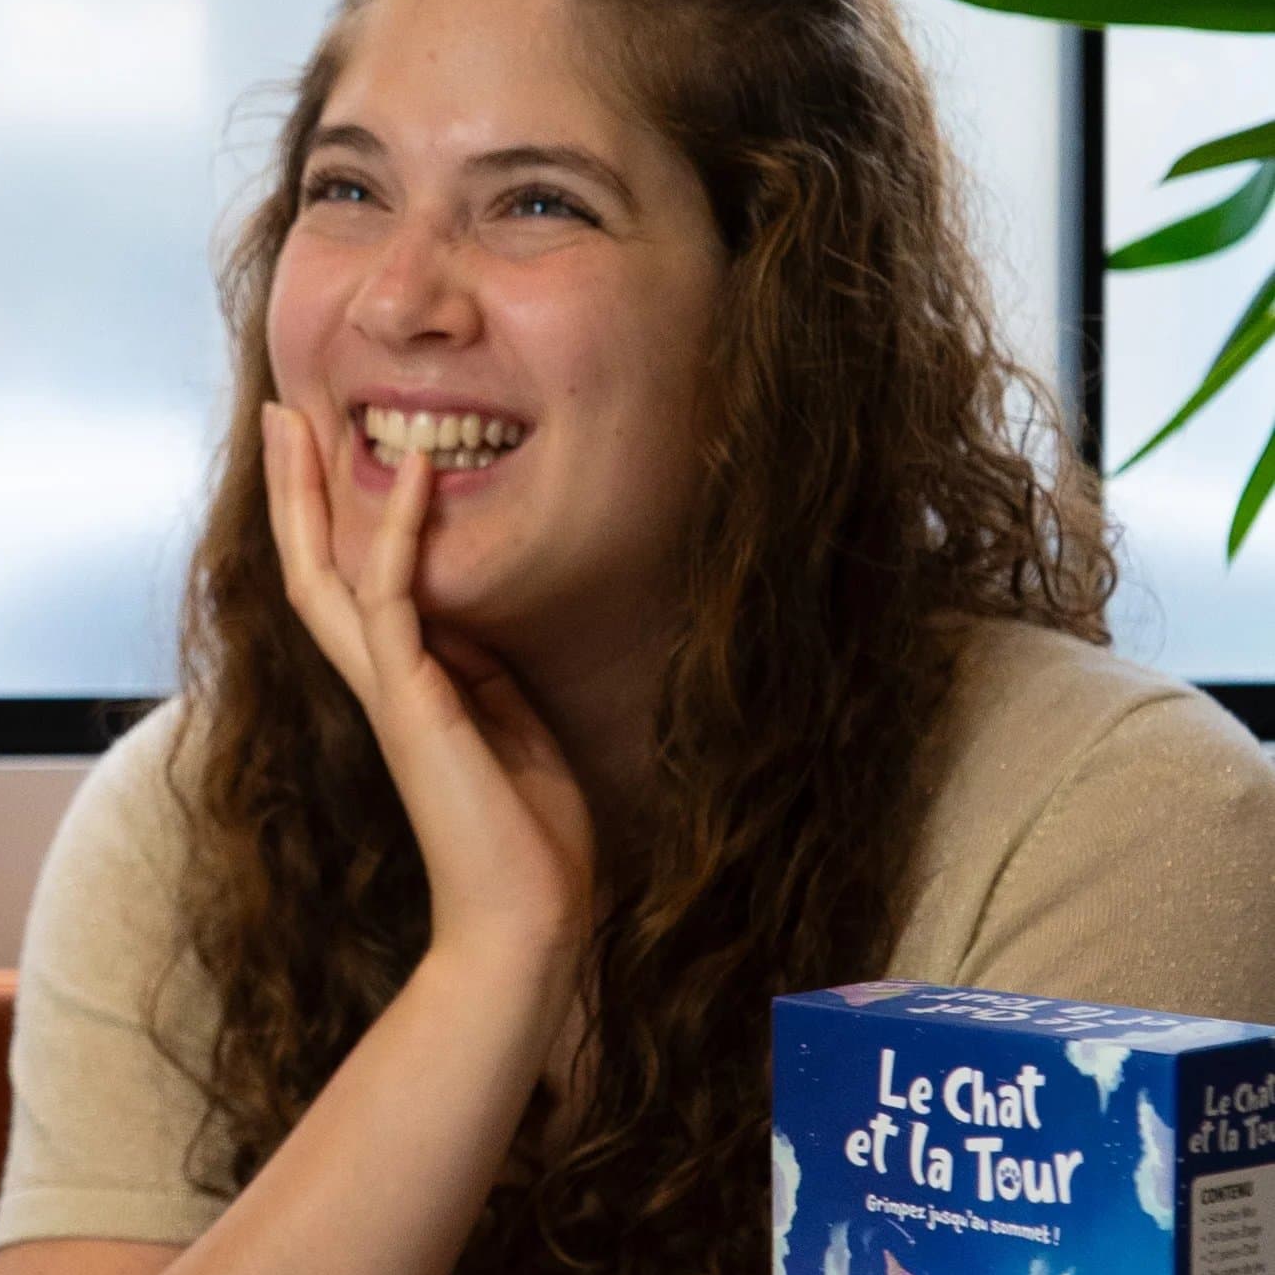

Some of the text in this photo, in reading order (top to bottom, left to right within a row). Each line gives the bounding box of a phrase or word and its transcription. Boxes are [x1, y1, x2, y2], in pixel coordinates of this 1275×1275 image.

[879, 1048, 1046, 1129] Le Chat
[1205, 1085, 1231, 1116] Le
[844, 1112, 1084, 1204] et la Tour
[1188, 1121, 1215, 1153] et
[1219, 1119, 1239, 1152] la
[865, 1193, 926, 1222] Grimpez
[926, 1204, 988, 1234] jusqu'au
[990, 1219, 1051, 1244] sommet
